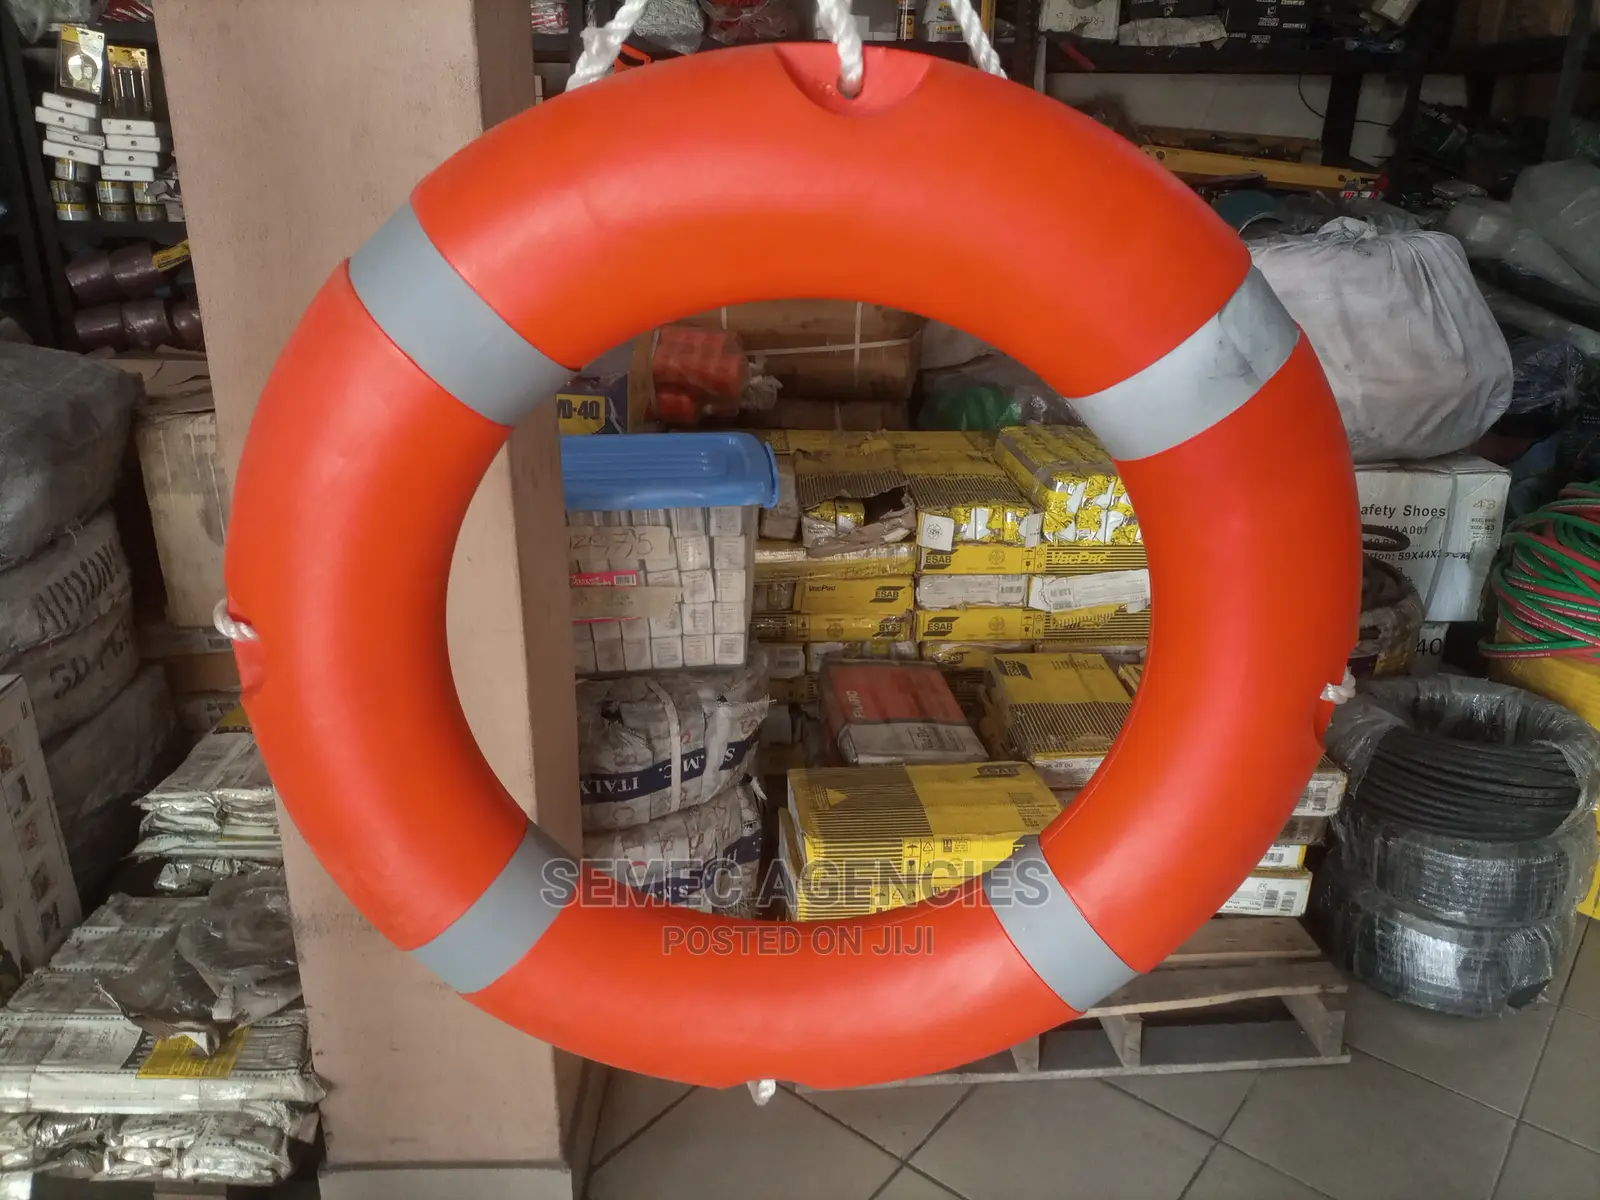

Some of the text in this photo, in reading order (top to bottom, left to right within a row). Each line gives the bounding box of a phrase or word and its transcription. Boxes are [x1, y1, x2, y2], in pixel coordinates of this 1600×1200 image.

[1361, 503, 1447, 519] afety Shoes
[926, 552, 1110, 565] ESAB VacPac
[875, 590, 899, 598] ESAB
[927, 622, 953, 631] ESAB
[1413, 637, 1442, 656] 40
